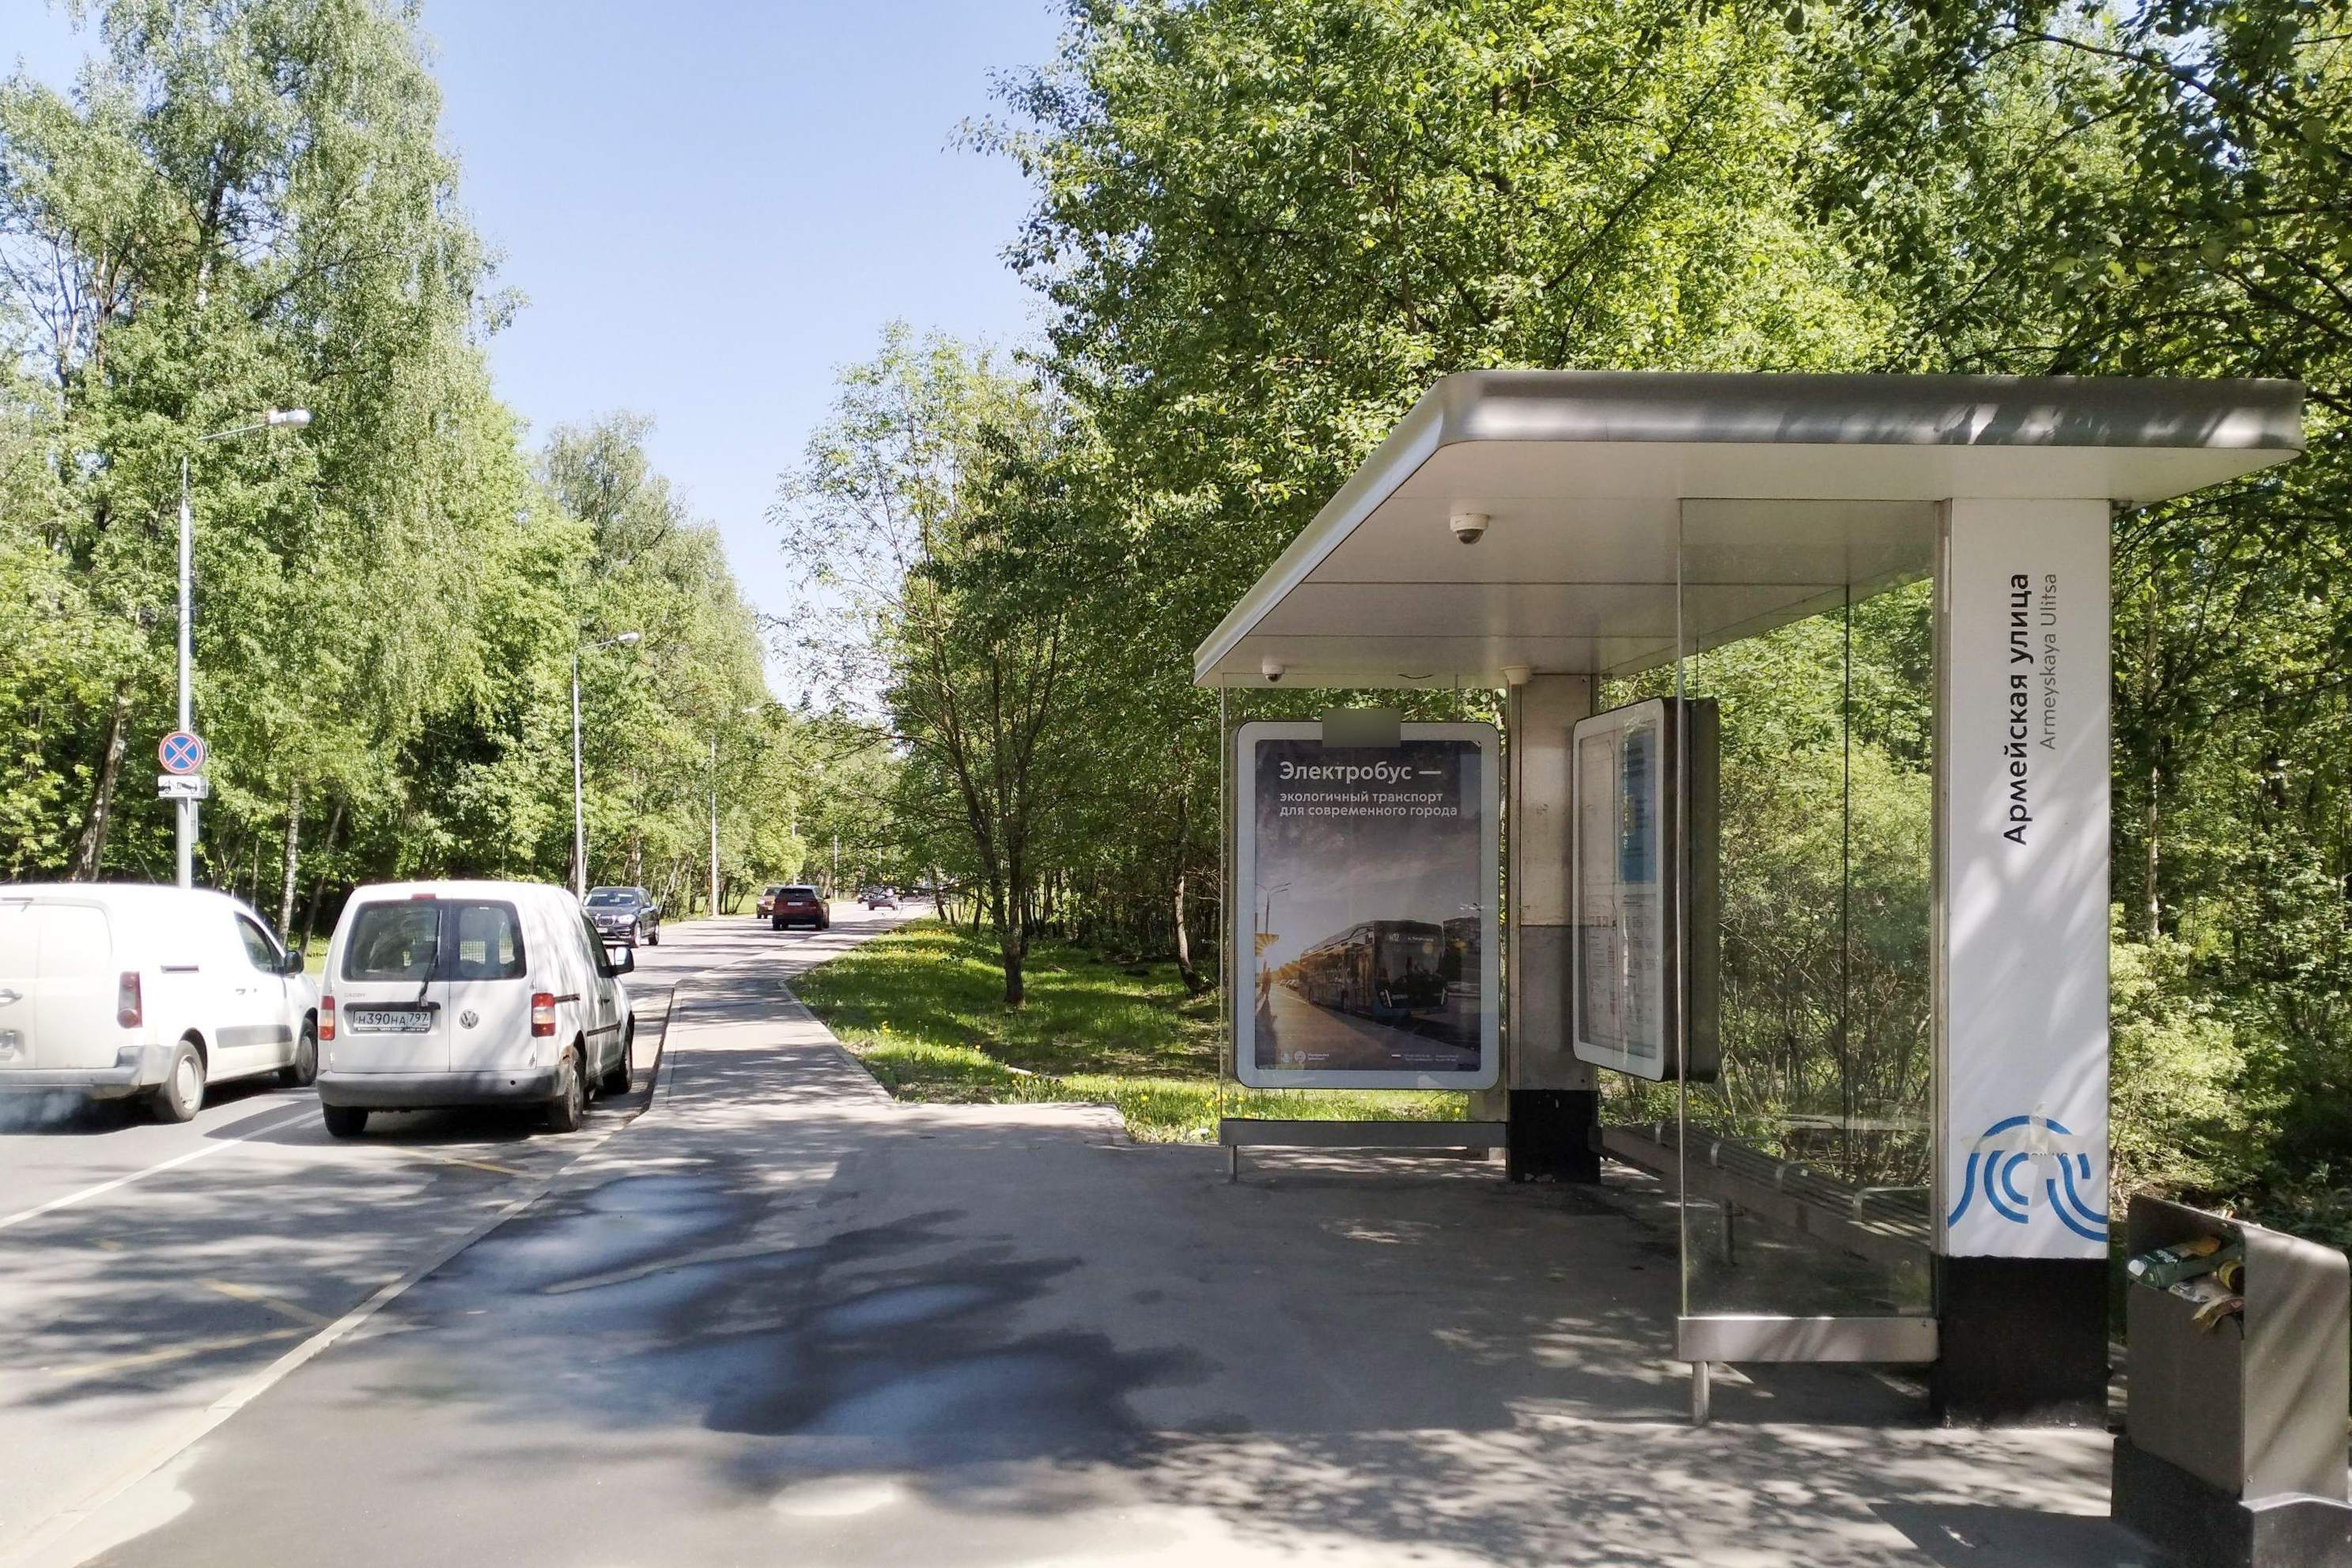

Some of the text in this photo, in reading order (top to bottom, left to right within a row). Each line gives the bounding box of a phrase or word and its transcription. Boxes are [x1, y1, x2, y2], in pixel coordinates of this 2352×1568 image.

[2039, 573, 2060, 750] Armeyskaya Ulitsa
[2003, 573, 2034, 846] Армейская улица
[1279, 761, 1412, 784] Электробус
[1280, 791, 1443, 803] экологичный транспорт
[1280, 806, 1458, 818] для современного города
[408, 1013, 428, 1023] 797
